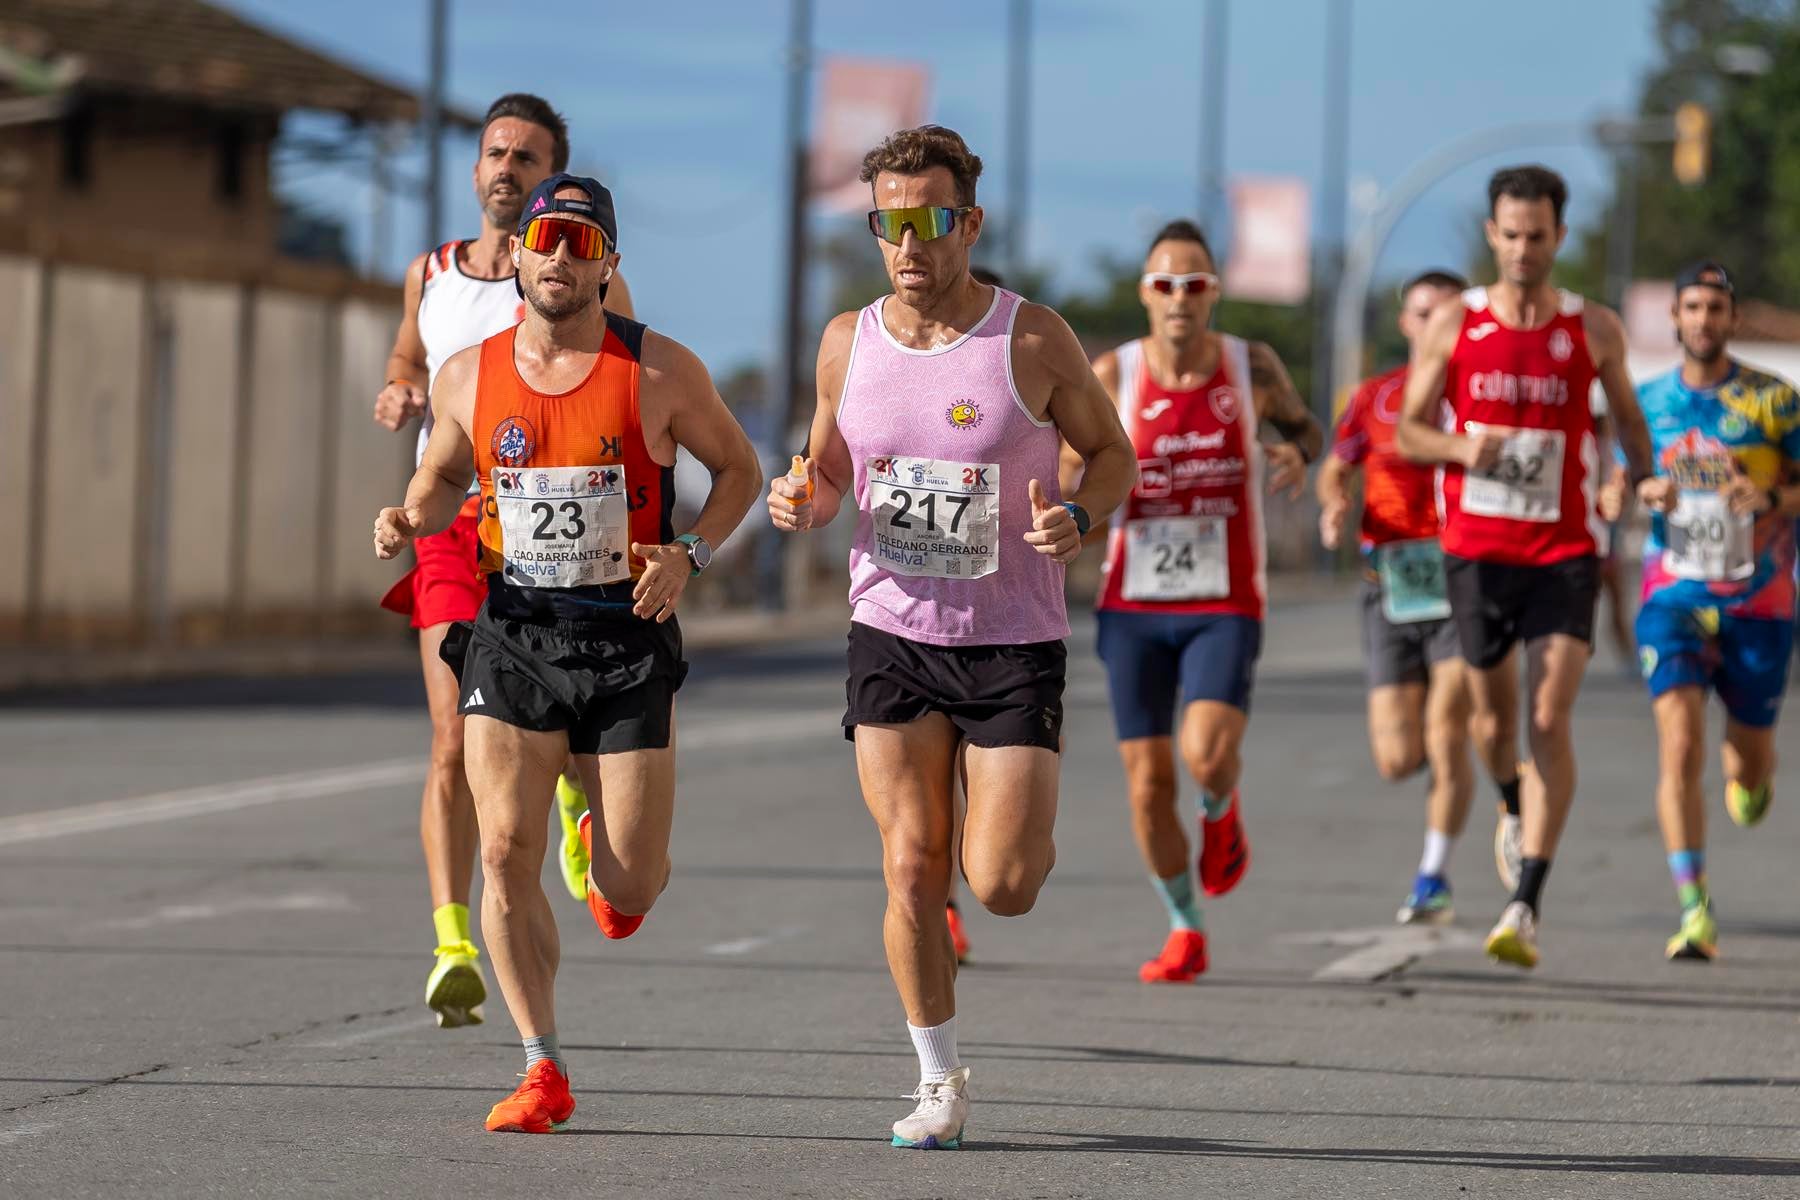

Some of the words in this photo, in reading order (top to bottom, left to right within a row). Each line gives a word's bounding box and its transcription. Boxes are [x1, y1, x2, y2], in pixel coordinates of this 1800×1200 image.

[875, 459, 898, 478] 21K
[962, 467, 989, 487] 21K
[926, 478, 949, 486] HUELVA
[531, 501, 586, 540] 23
[890, 489, 971, 534] 217
[876, 532, 928, 552] TOLEDANO
[931, 543, 988, 555] SERRANO
[513, 549, 534, 561] CAO
[536, 547, 610, 562] BARRANTES
[879, 543, 923, 566] Huelva
[1154, 542, 1195, 574] 24
[510, 559, 556, 576] Huelva
